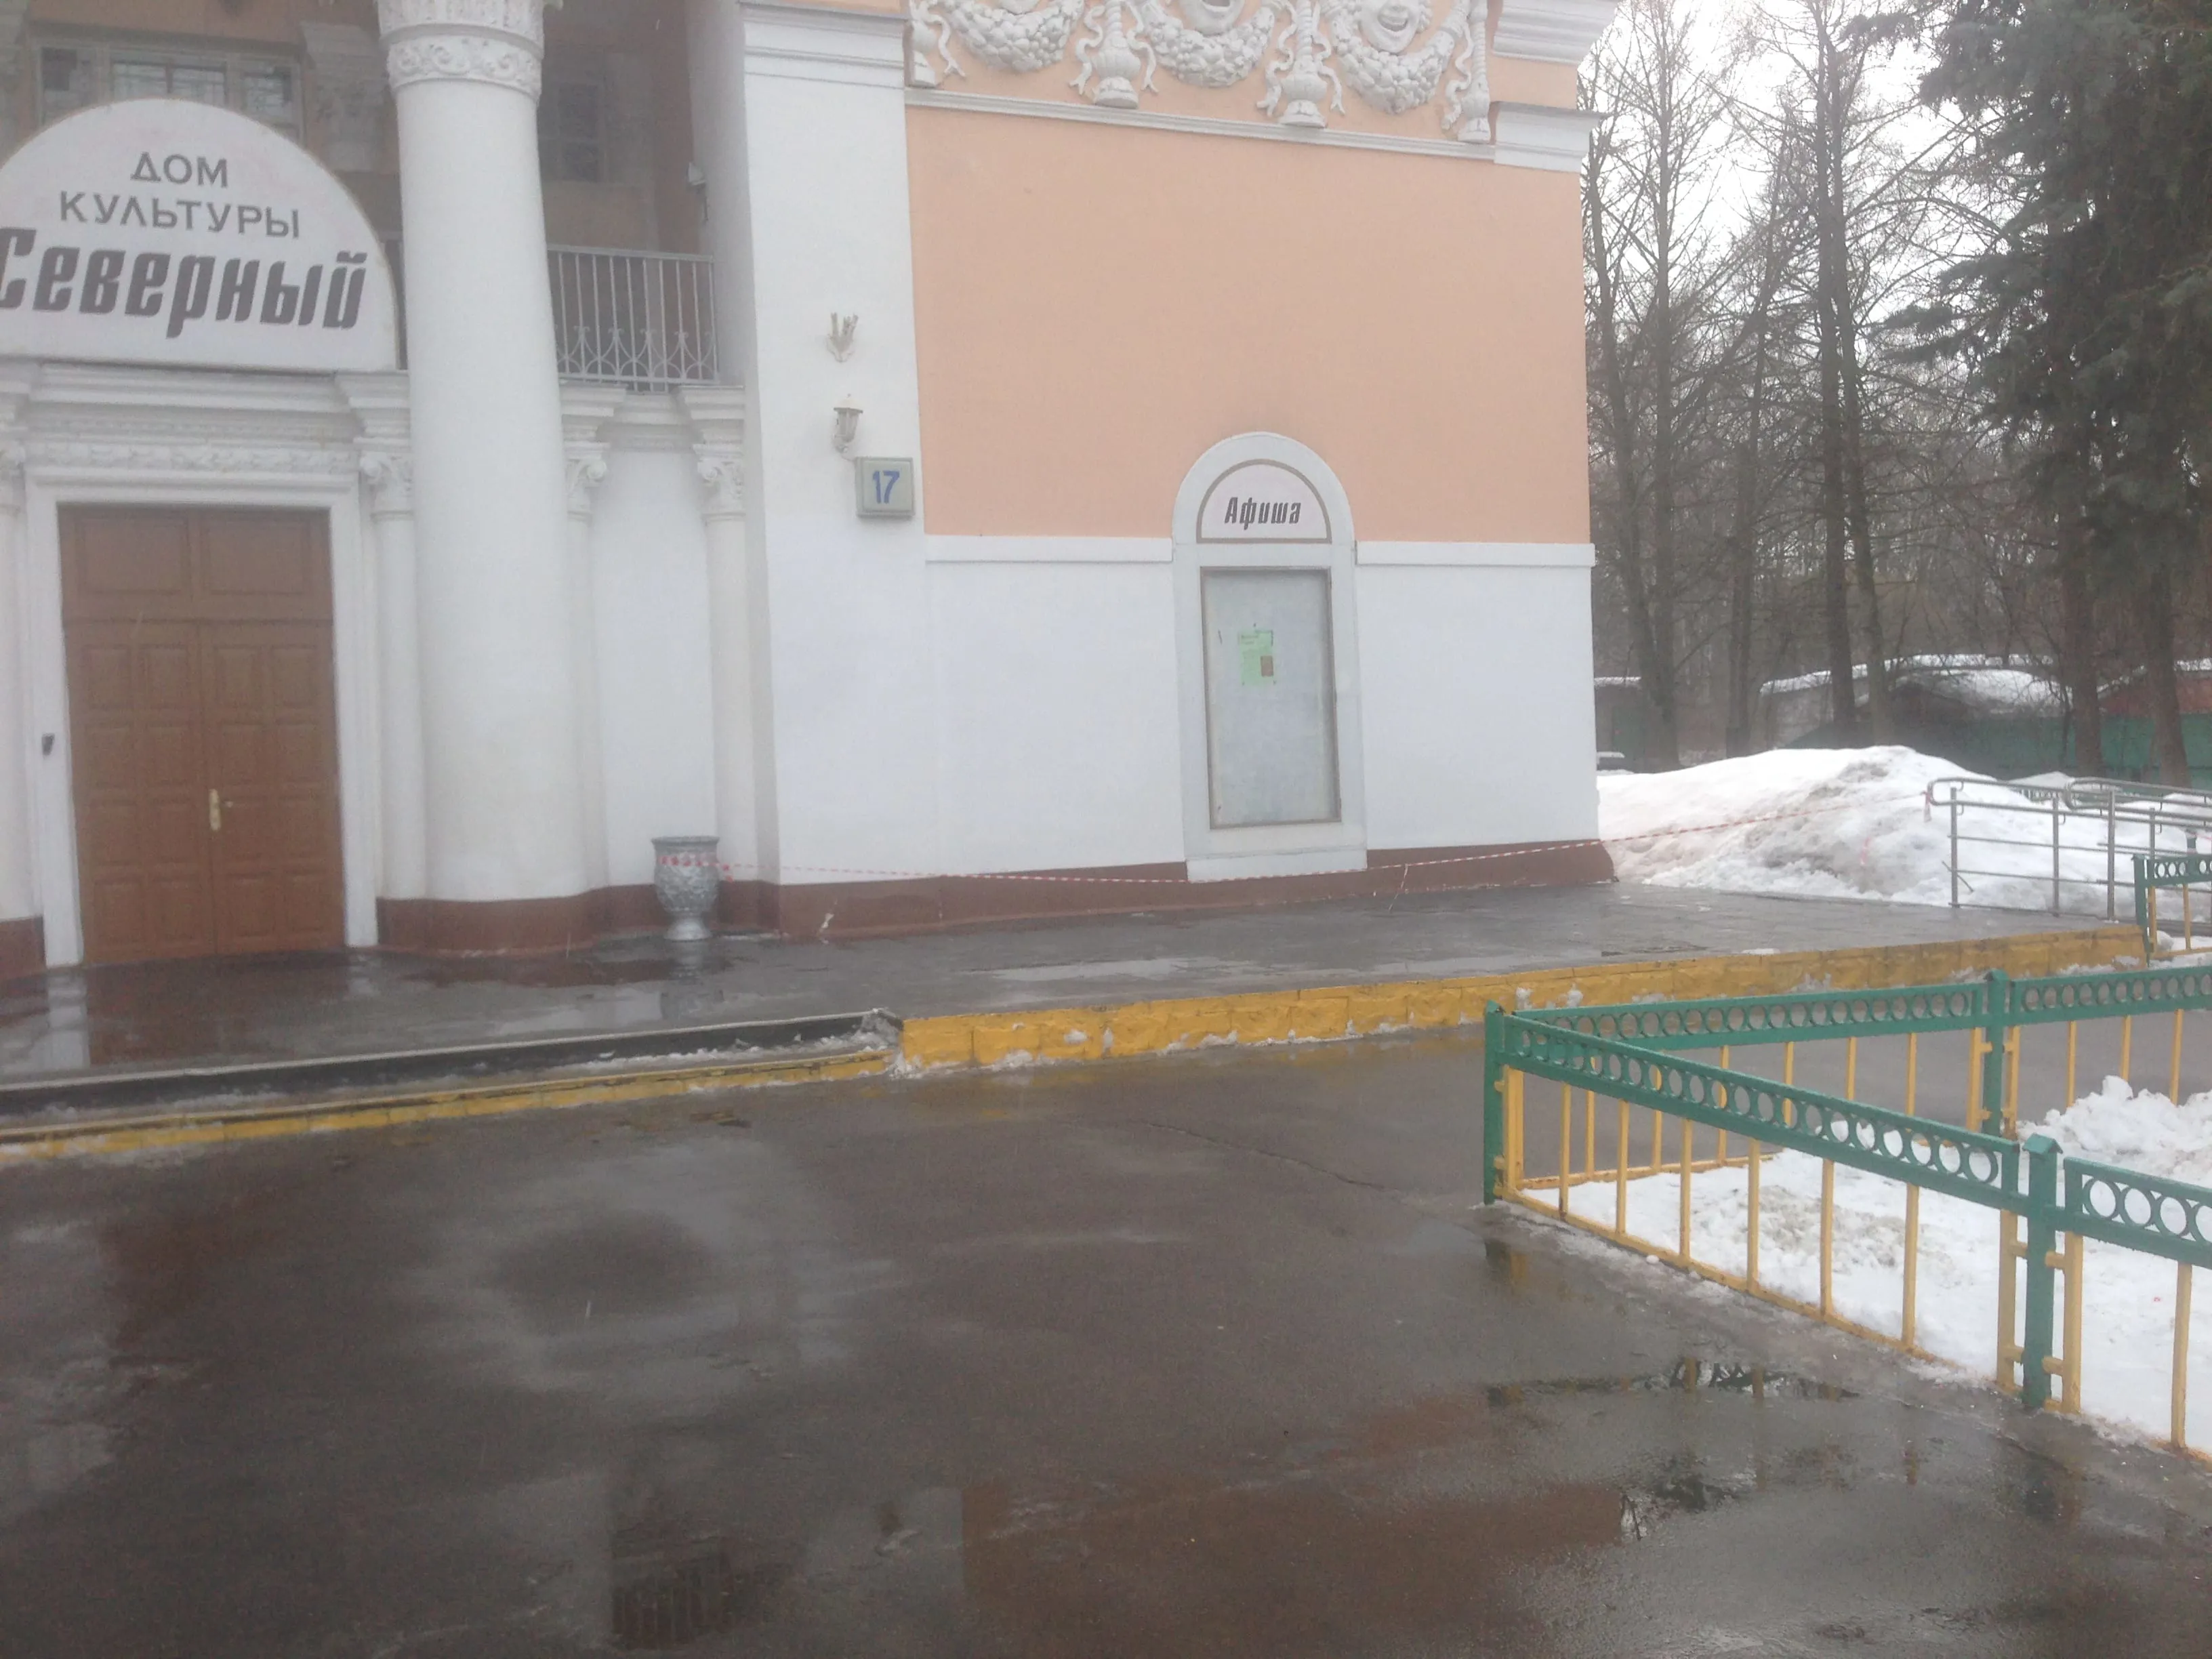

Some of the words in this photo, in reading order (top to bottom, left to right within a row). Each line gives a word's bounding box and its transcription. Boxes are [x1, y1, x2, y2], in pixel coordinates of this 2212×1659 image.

[129, 151, 228, 188] ДОМ
[60, 191, 300, 239] КУЛЬТУРЫ
[0, 226, 367, 338] Северный
[872, 470, 900, 504] 17
[1224, 497, 1301, 530] Афиша
